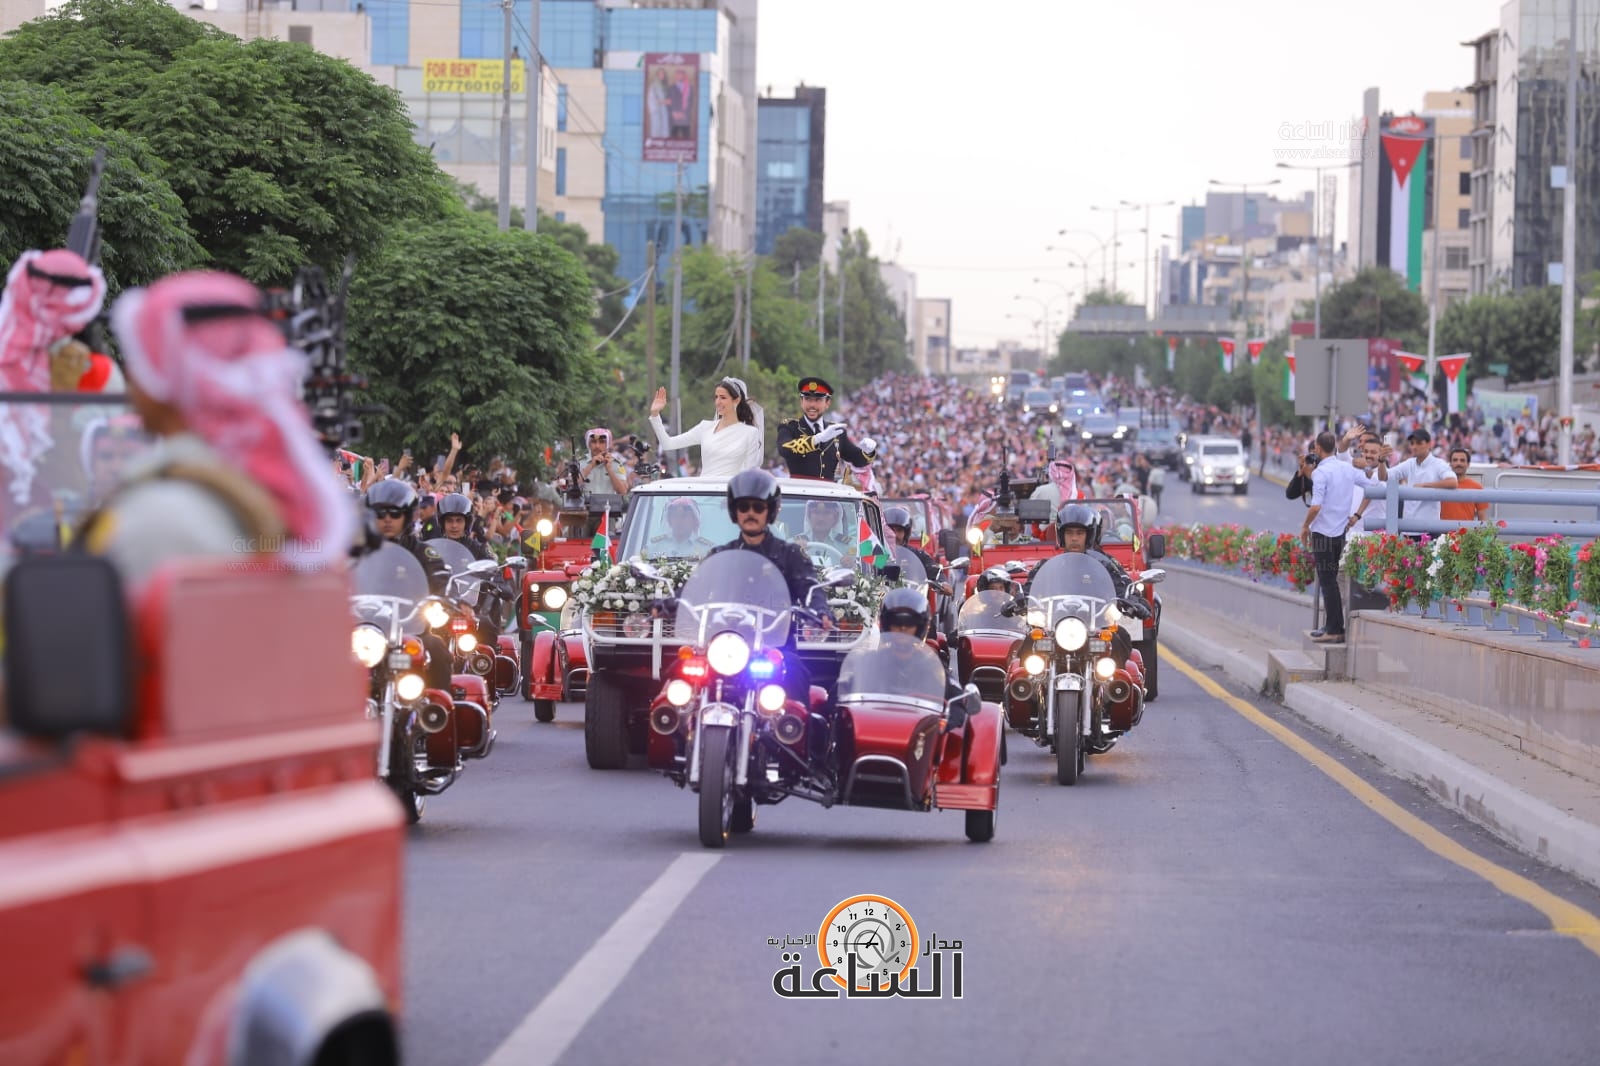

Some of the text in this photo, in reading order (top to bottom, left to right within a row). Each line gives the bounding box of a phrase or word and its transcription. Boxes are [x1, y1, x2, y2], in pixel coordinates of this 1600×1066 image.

[427, 63, 446, 78] FOR
[450, 63, 478, 78] RENT
[427, 81, 519, 92] 077760100
